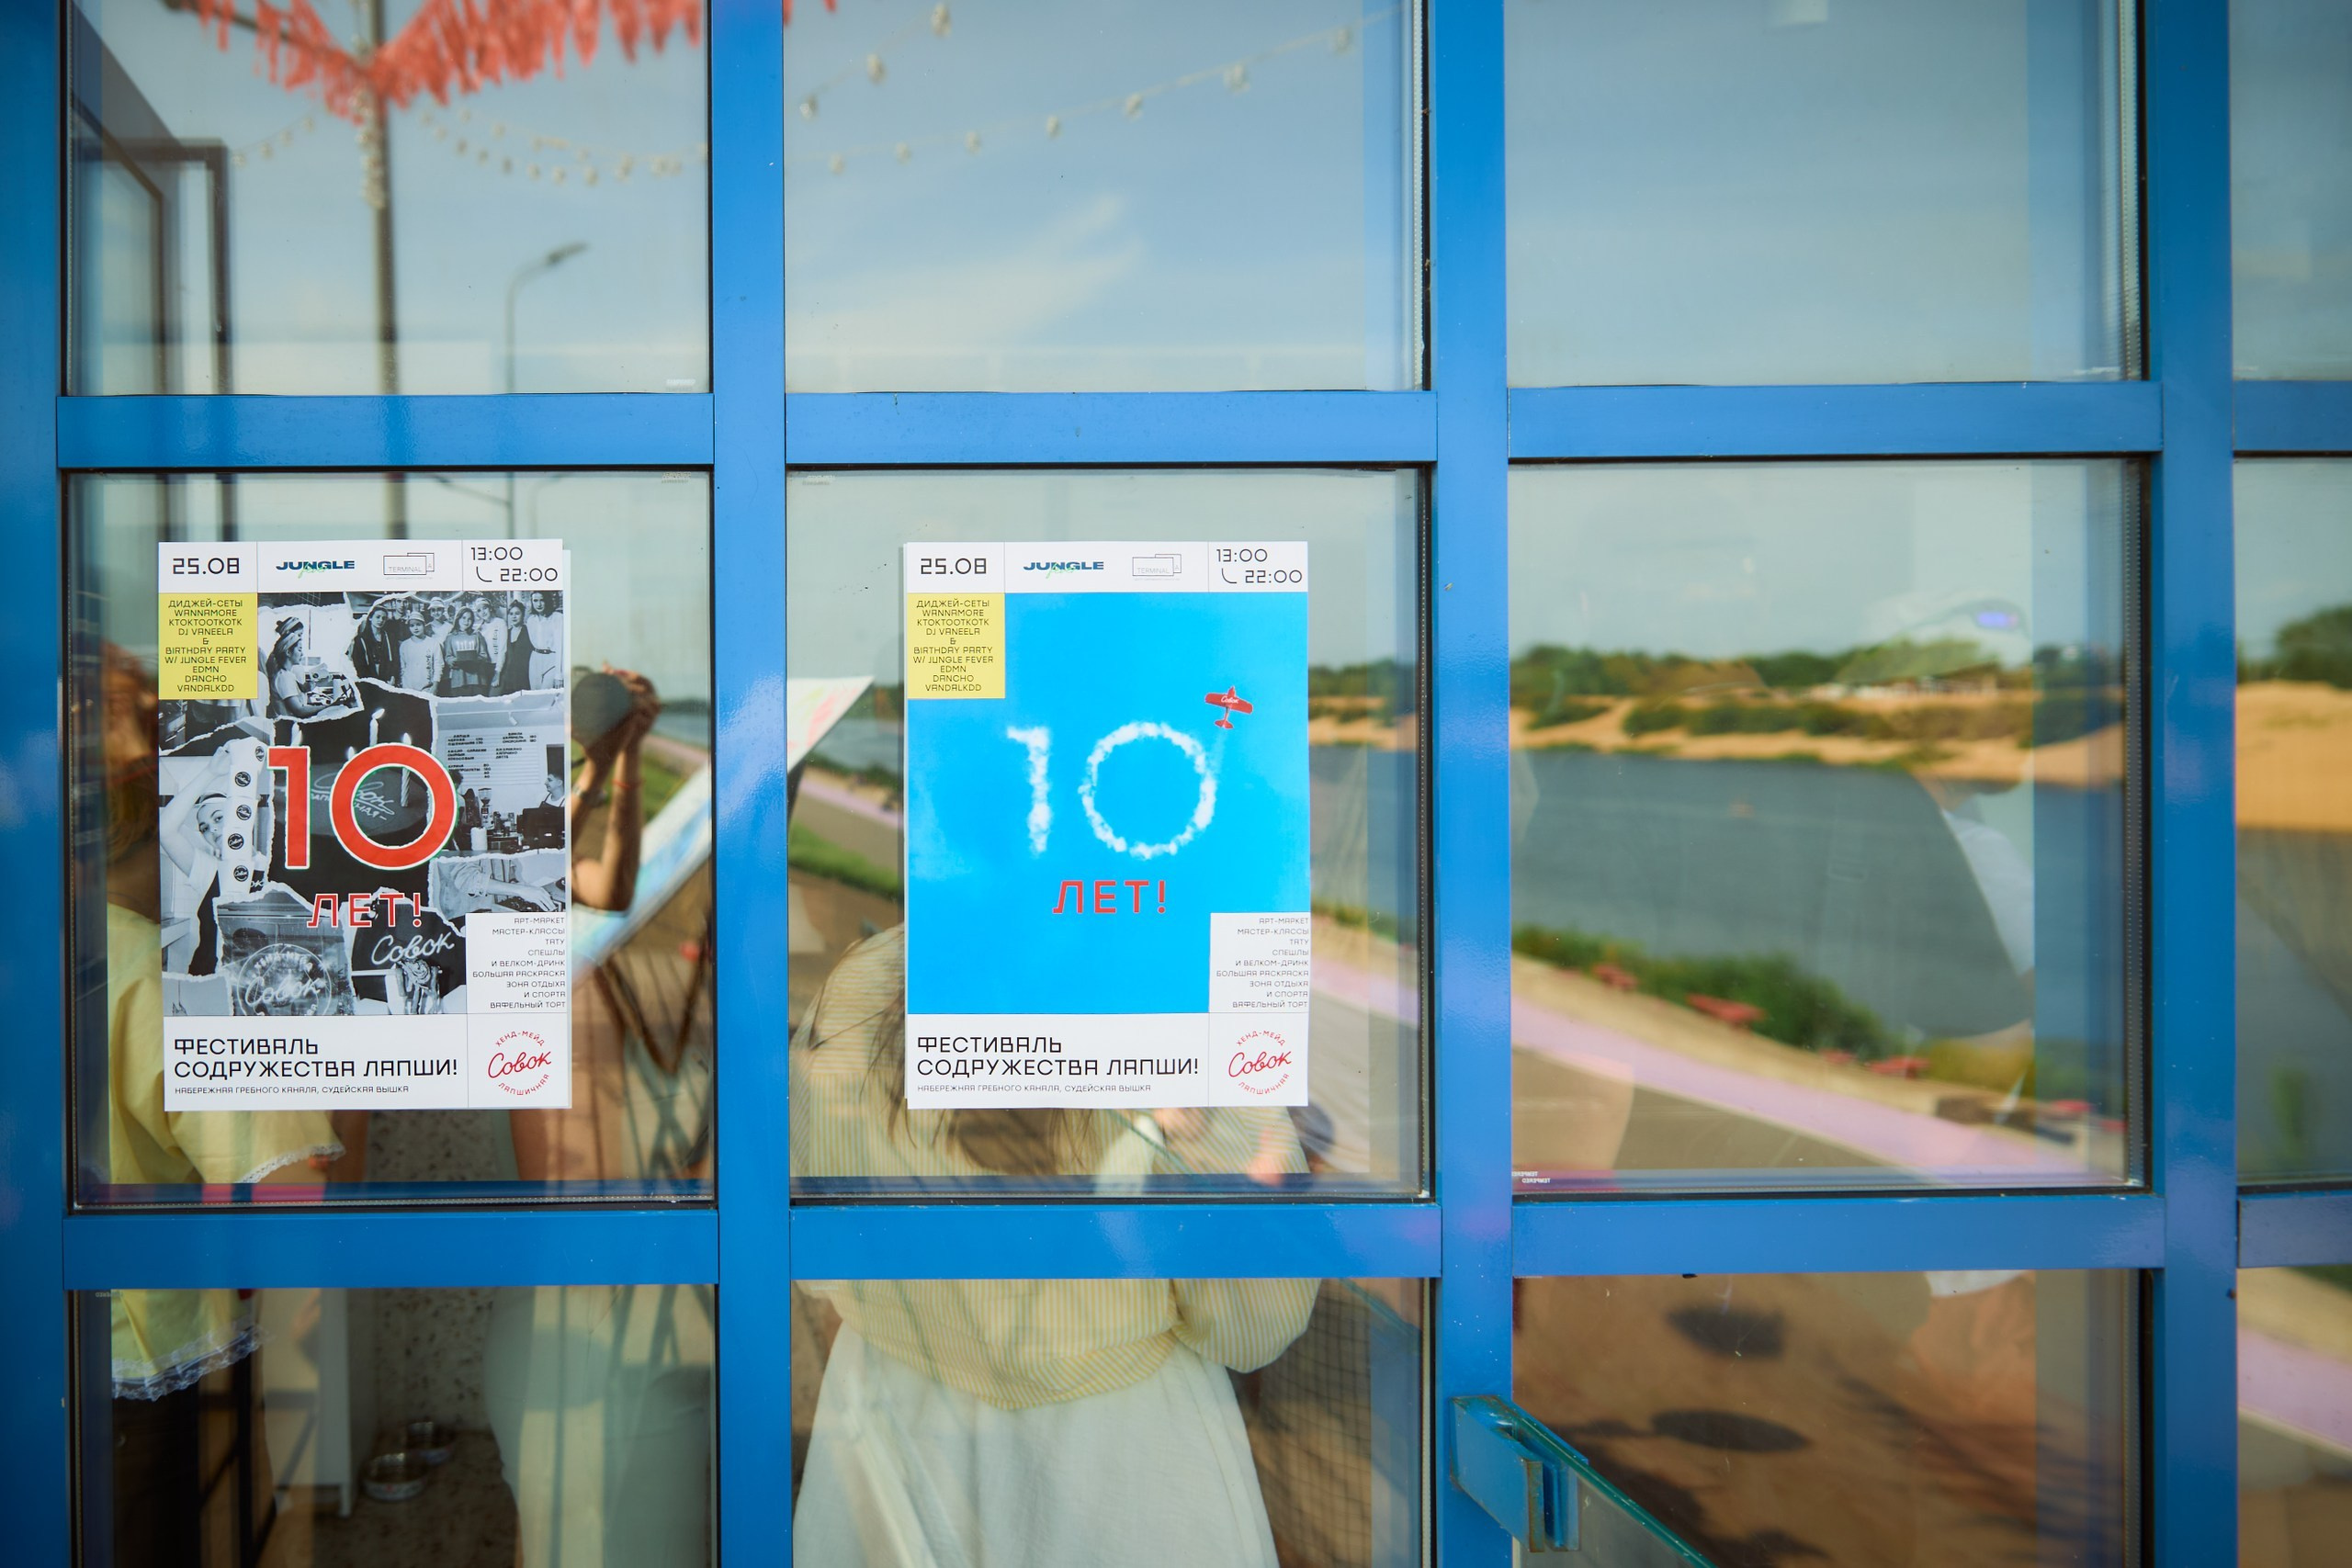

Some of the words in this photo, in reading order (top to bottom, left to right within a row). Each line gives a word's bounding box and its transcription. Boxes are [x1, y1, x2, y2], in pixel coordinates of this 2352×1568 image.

[471, 547, 523, 560] 13:00
[1216, 549, 1267, 562] 13:00
[173, 558, 239, 574] 25.08
[276, 560, 355, 570] JUNGLE
[921, 558, 986, 574] 25.08
[1023, 561, 1103, 570] JUNGLE
[501, 568, 558, 581] 22:00
[1246, 570, 1302, 583] 22:00
[168, 598, 243, 608] ДИДЖЕЙ-СЕТЫ
[917, 598, 989, 608] ДИДЖЕЙ-СЕТЫ
[1005, 722, 1216, 861] 10
[267, 743, 457, 870] 10
[1053, 880, 1166, 914] ЛЕТ!
[306, 893, 422, 928] ЛЕТ!
[371, 931, 455, 965] Совок
[491, 1000, 542, 1009] ВАФЕЛЬНЫЙ
[496, 1031, 544, 1046] ХЕНД-МЕЙД
[918, 1037, 1061, 1053] ФЕСТИВАЛЬ
[1237, 1031, 1285, 1046] ХЕНД-МЕЙД
[175, 1039, 318, 1055] ФЕСТИВАЛЬ
[175, 1061, 355, 1080] СОДРУЖЕСТВА
[364, 1059, 457, 1077] ЛАПШИ!
[488, 1052, 551, 1079] Совок
[918, 1059, 1097, 1077] СОДРУЖЕСТВА
[1107, 1058, 1197, 1075] ЛАПШИ!
[1228, 1052, 1291, 1078] Совок
[322, 1085, 373, 1093] СУДЕЙСКАЯ
[497, 1073, 548, 1095] ЛАПШИЧНАЯ
[1065, 1084, 1116, 1092] СУДЕЙСКАЯ
[1238, 1073, 1289, 1094] ЛАПШИЧНАЯ
